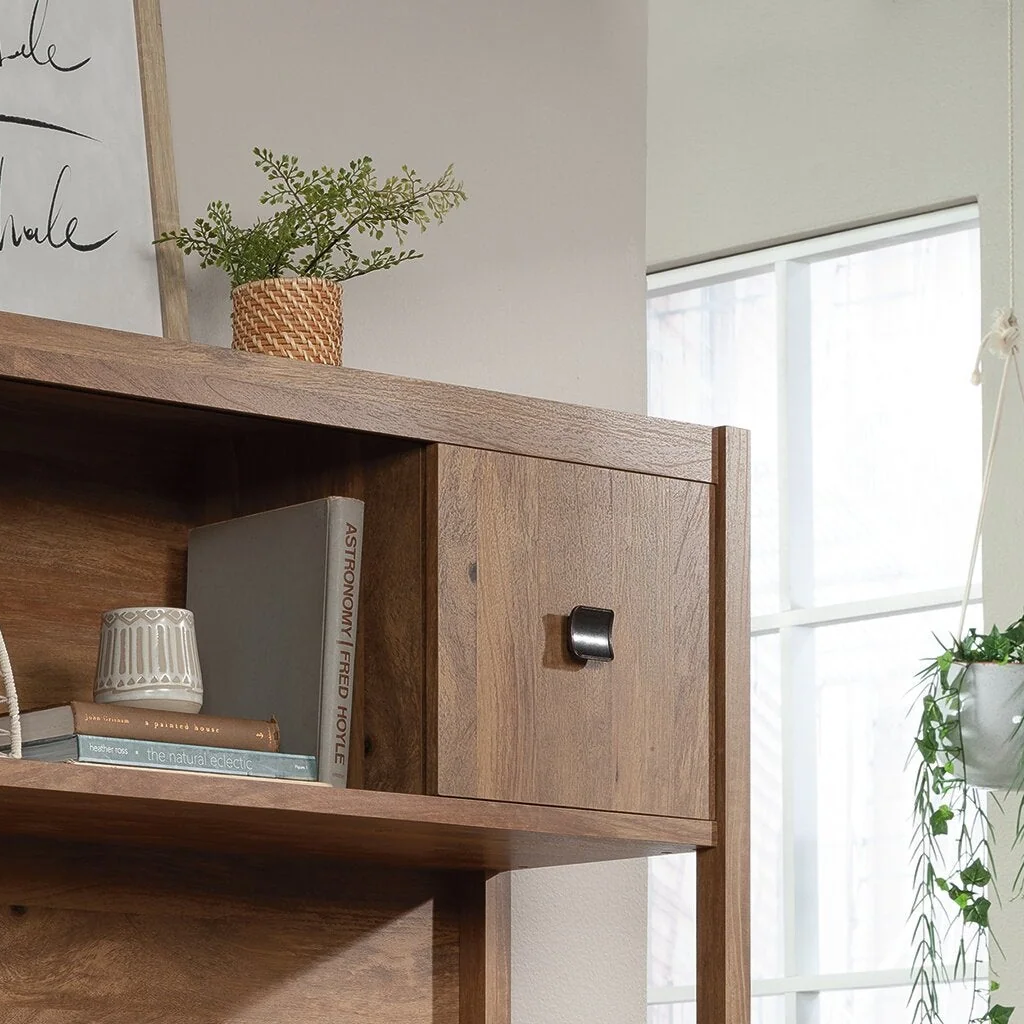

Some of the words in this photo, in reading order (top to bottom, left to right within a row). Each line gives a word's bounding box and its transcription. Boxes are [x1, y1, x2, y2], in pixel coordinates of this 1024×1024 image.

[341, 522, 357, 638] ASTRONOMY
[339, 650, 351, 700] FRED
[154, 721, 190, 731] painted
[194, 723, 220, 733] house
[335, 705, 348, 766] HOYLE
[89, 742, 114, 754] heather
[115, 747, 129, 755] ross
[147, 746, 166, 762] the
[169, 751, 207, 766] natural
[210, 754, 254, 770] eclectic
